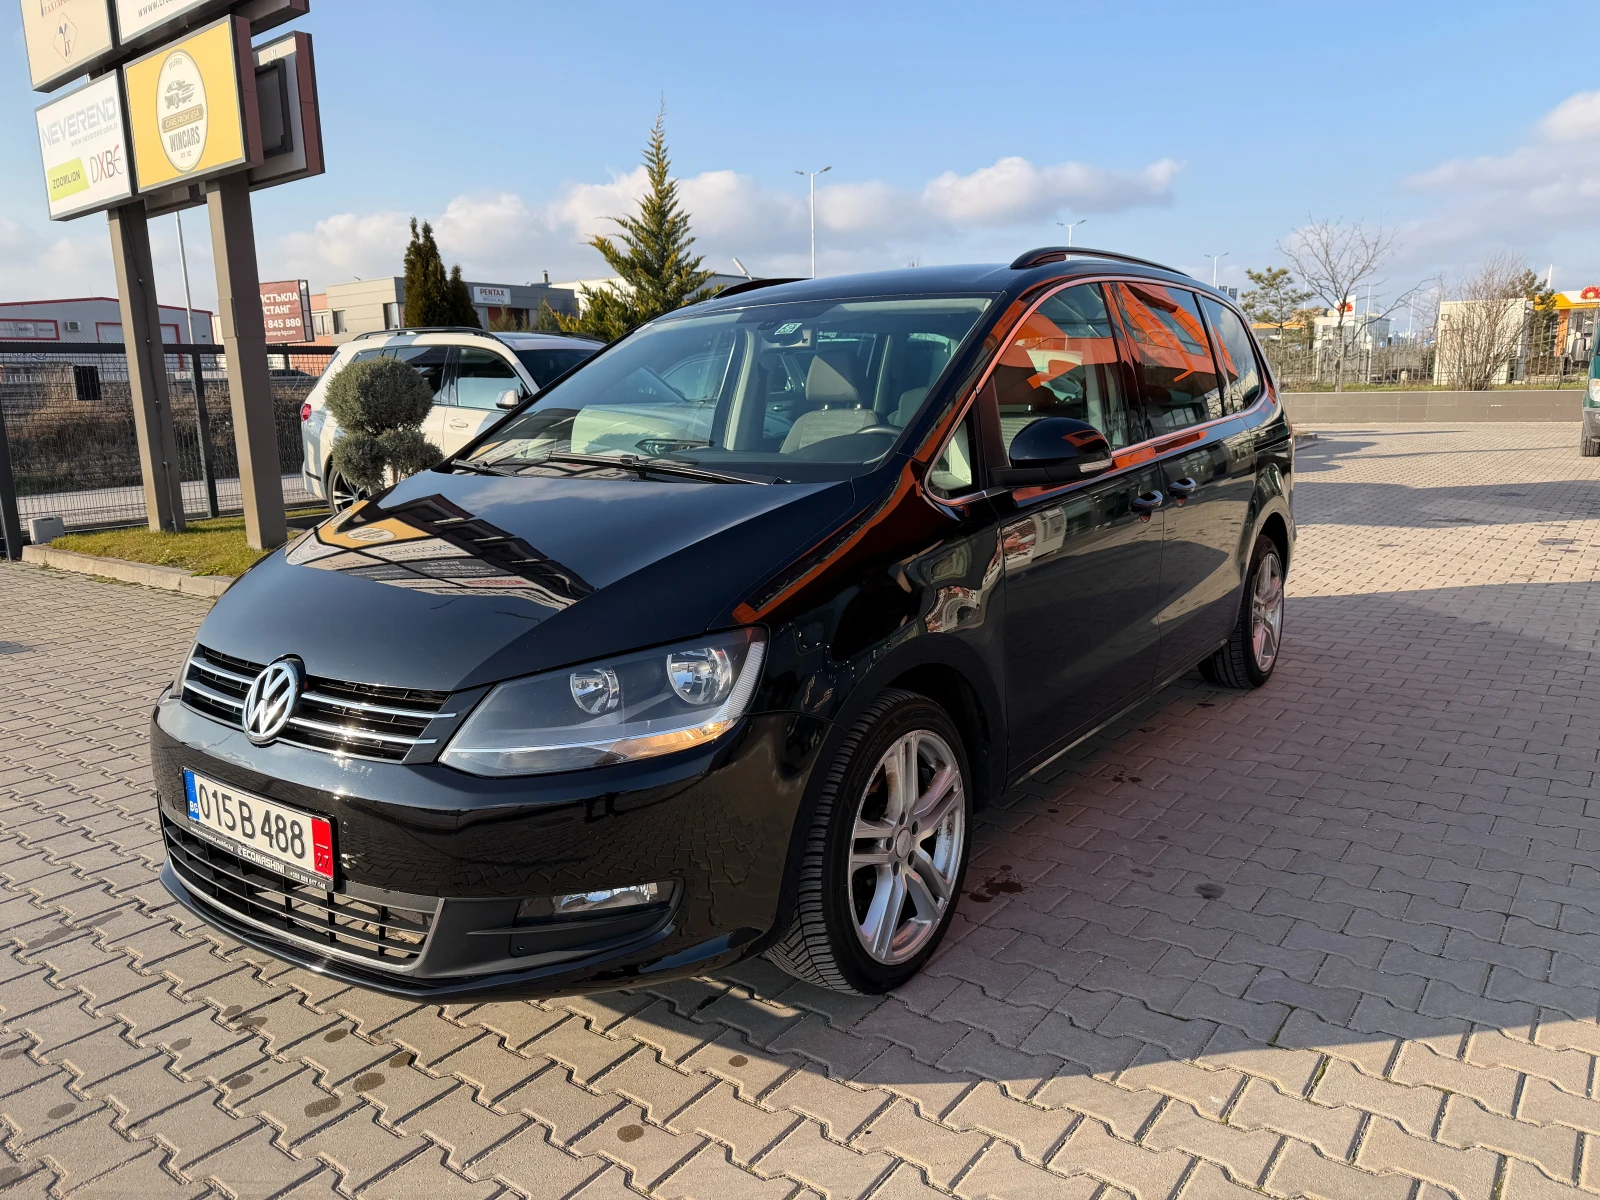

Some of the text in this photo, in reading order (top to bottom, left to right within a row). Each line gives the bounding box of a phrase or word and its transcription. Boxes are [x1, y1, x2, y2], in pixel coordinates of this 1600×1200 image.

[41, 96, 117, 149] NEVEREND
[169, 126, 200, 152] WINCARS
[52, 170, 81, 189] ZOOMLION
[480, 289, 505, 297] PENTAX
[263, 305, 290, 315] СТАНГ
[268, 318, 300, 328] 845 880
[190, 801, 198, 812] BG
[243, 848, 285, 874] ECOMASHINI
